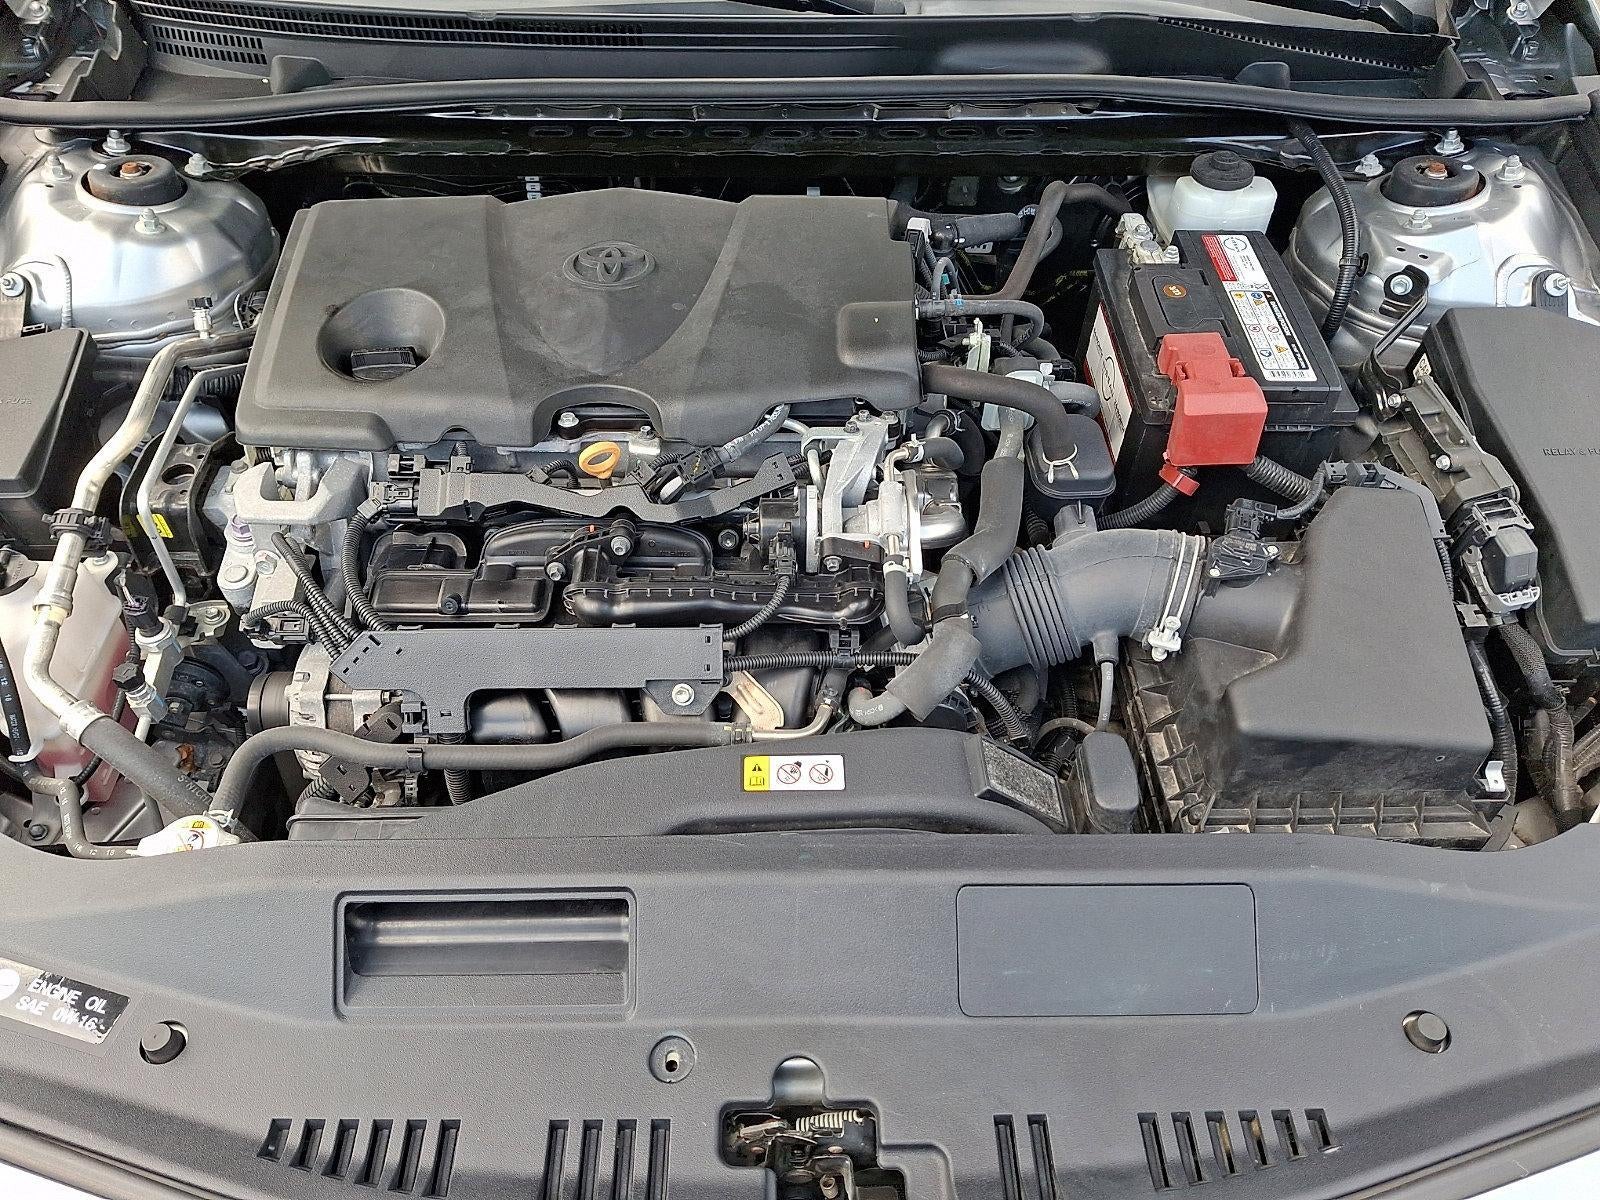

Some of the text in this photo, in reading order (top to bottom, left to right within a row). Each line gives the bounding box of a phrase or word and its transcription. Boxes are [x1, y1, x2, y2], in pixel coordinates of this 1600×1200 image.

[1542, 447, 1577, 457] RELAY
[15, 995, 49, 1017] SAE
[27, 977, 108, 1015] ENGINE OIL
